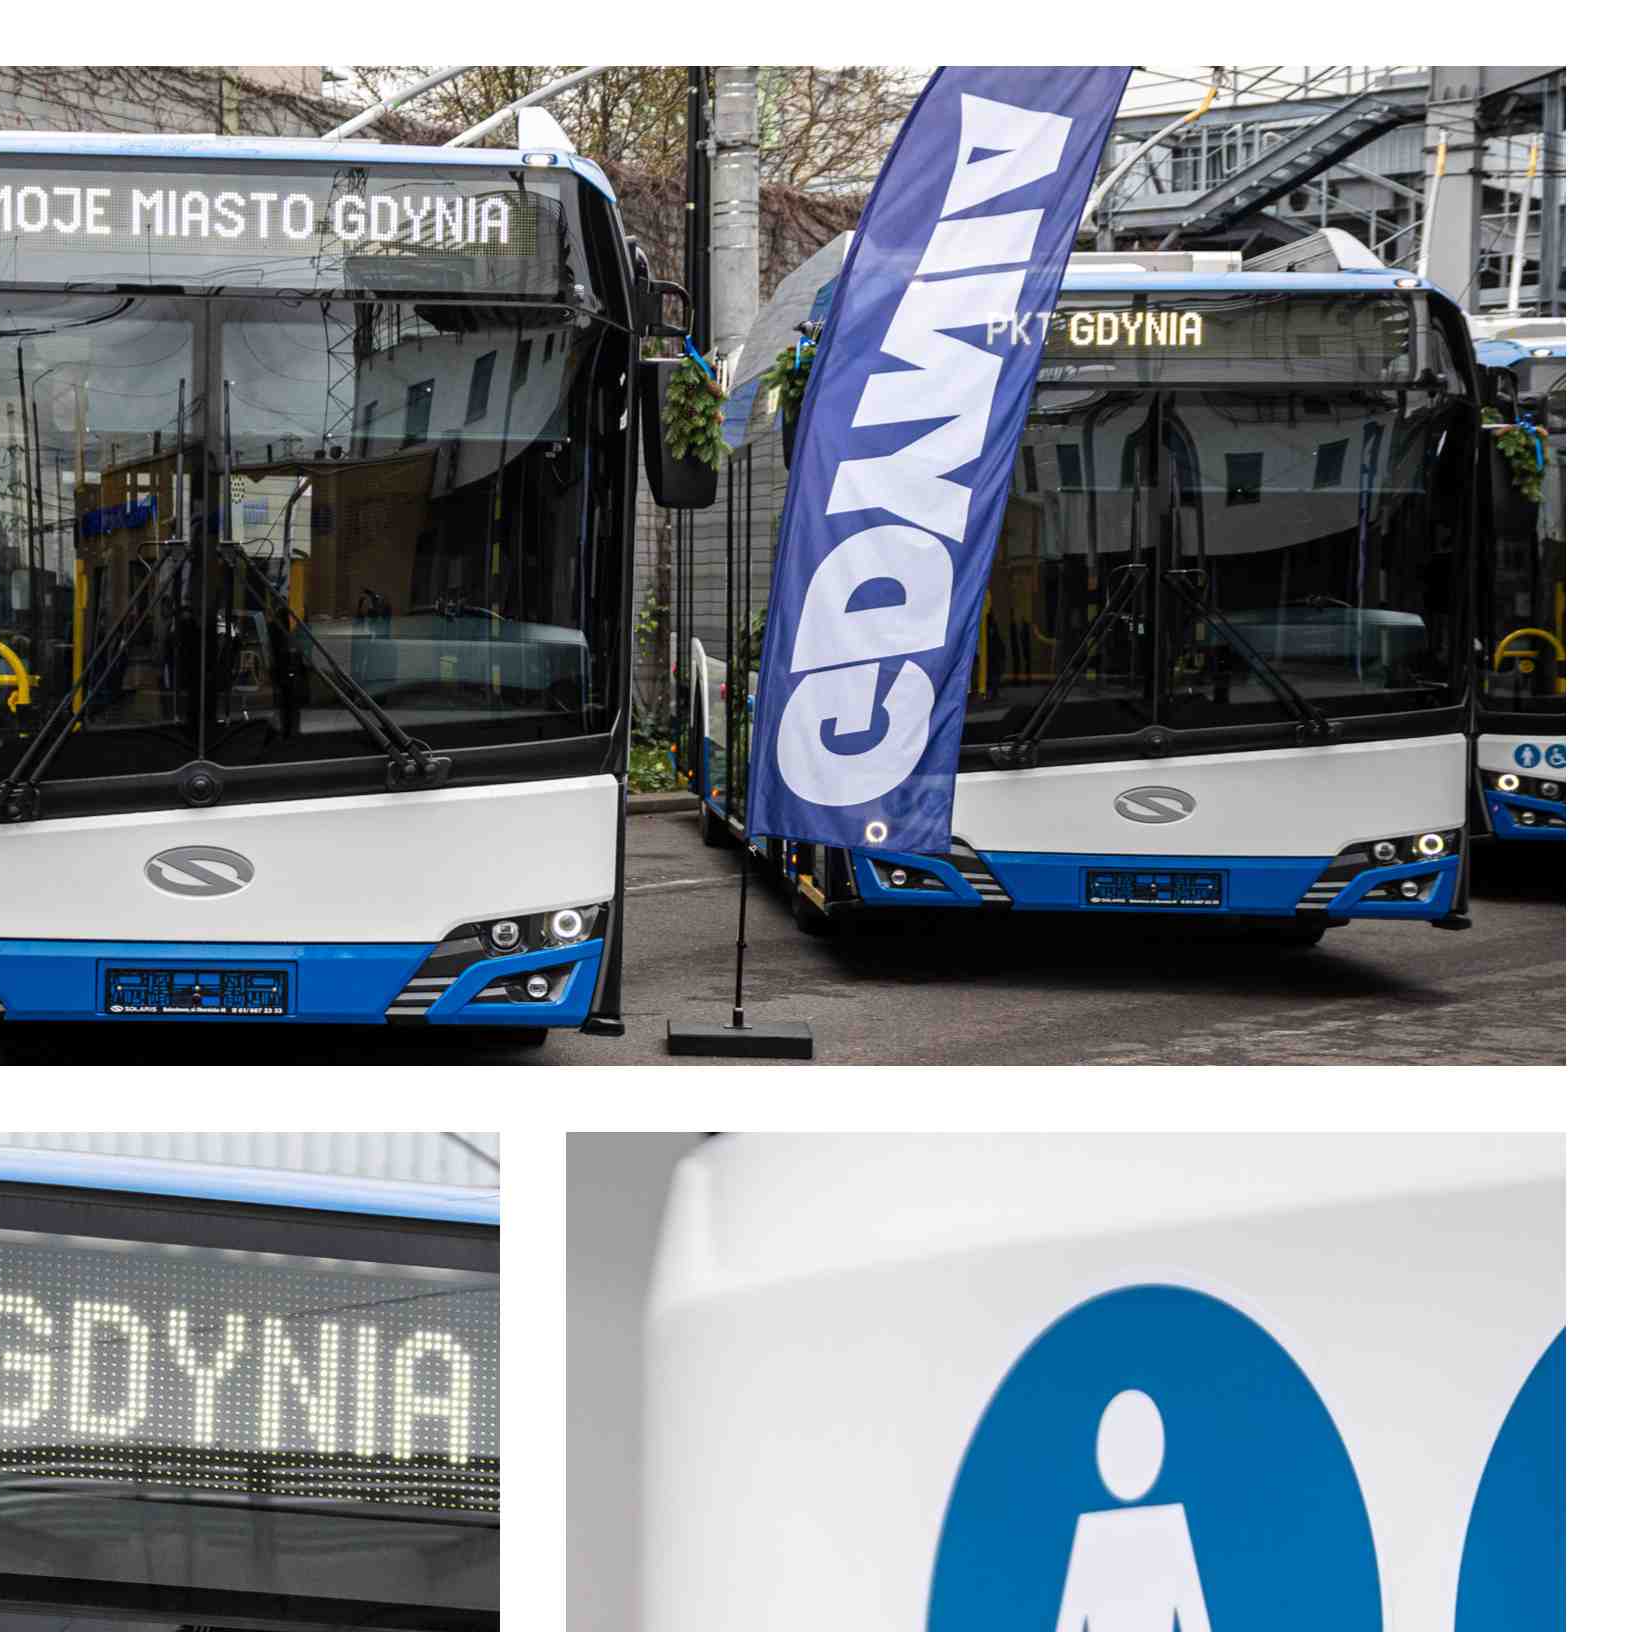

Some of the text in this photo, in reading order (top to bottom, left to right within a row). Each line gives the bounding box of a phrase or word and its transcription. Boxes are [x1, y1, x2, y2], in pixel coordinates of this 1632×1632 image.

[131, 188, 313, 240] MIASTO
[333, 194, 511, 245] GDYNIA
[1070, 310, 1204, 347] GDYNIA
